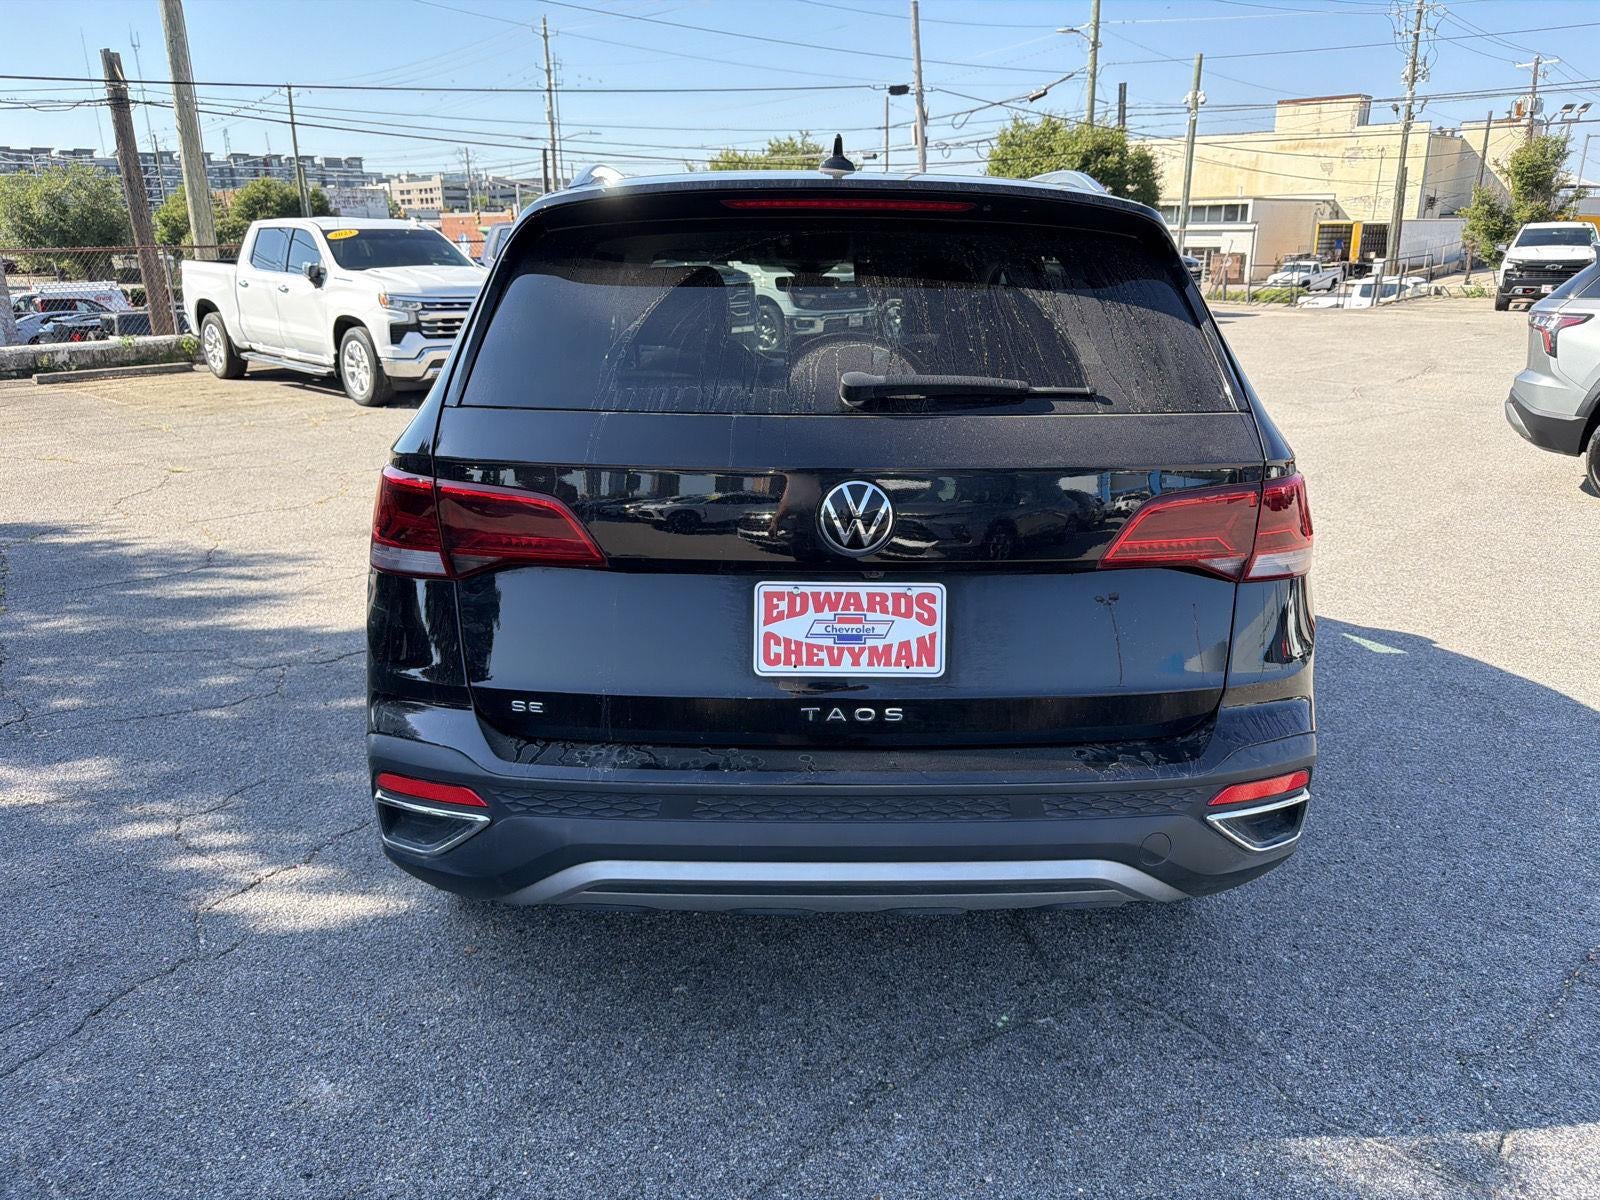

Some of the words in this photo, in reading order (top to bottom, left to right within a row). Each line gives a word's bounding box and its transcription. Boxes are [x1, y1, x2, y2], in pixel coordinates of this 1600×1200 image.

[821, 481, 893, 554] VW
[763, 591, 937, 627] EDWARDS
[824, 624, 876, 634] Chevrolet
[763, 630, 937, 668] CHEVYMAN
[511, 700, 544, 713] SE
[801, 707, 904, 722] TAOS
